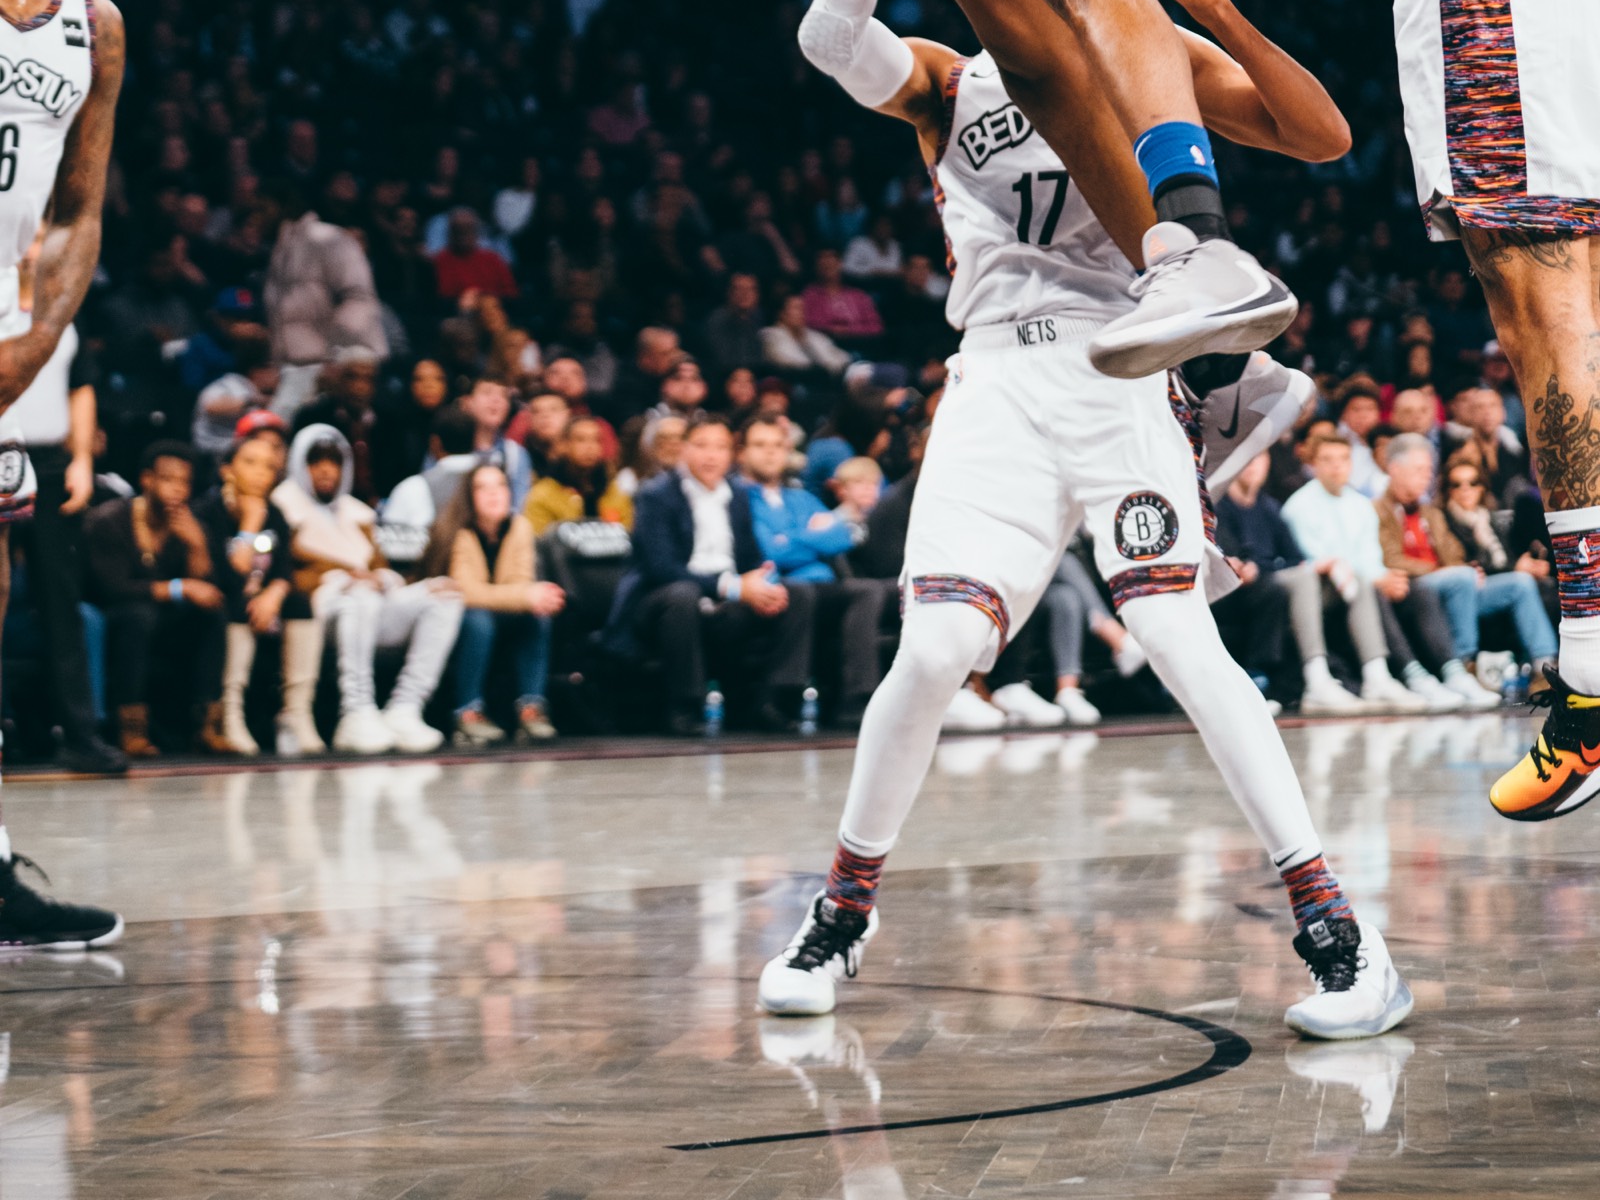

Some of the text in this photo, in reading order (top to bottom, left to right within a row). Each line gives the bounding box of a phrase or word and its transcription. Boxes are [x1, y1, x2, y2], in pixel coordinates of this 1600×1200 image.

[0, 121, 19, 192] 6
[1012, 170, 1070, 246] 17
[1017, 318, 1057, 347] NETS
[1135, 511, 1151, 541] B
